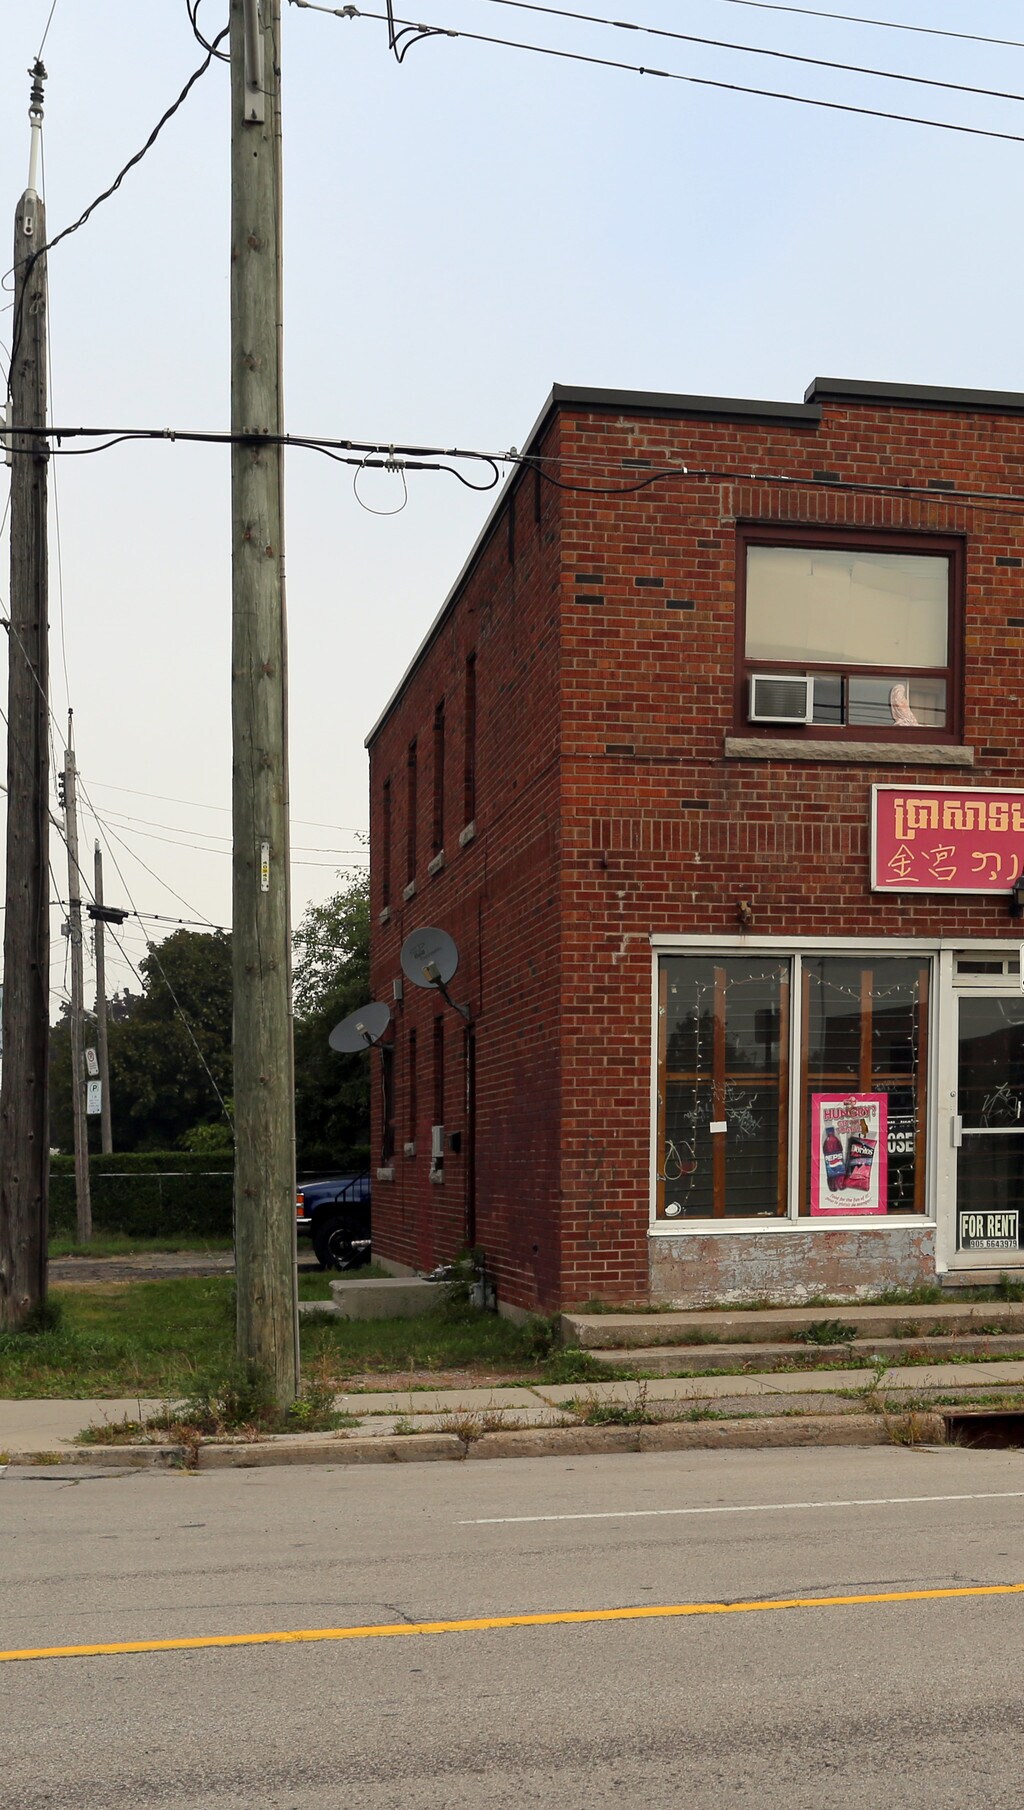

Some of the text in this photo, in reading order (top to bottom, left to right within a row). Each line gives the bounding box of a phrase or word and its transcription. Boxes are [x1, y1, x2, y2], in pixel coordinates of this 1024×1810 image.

[851, 1143, 874, 1155] Doritos
[887, 1132, 914, 1153] OSE
[962, 1214, 1016, 1237] FOR RENT
[970, 1240, 1017, 1248] 905 6643979
